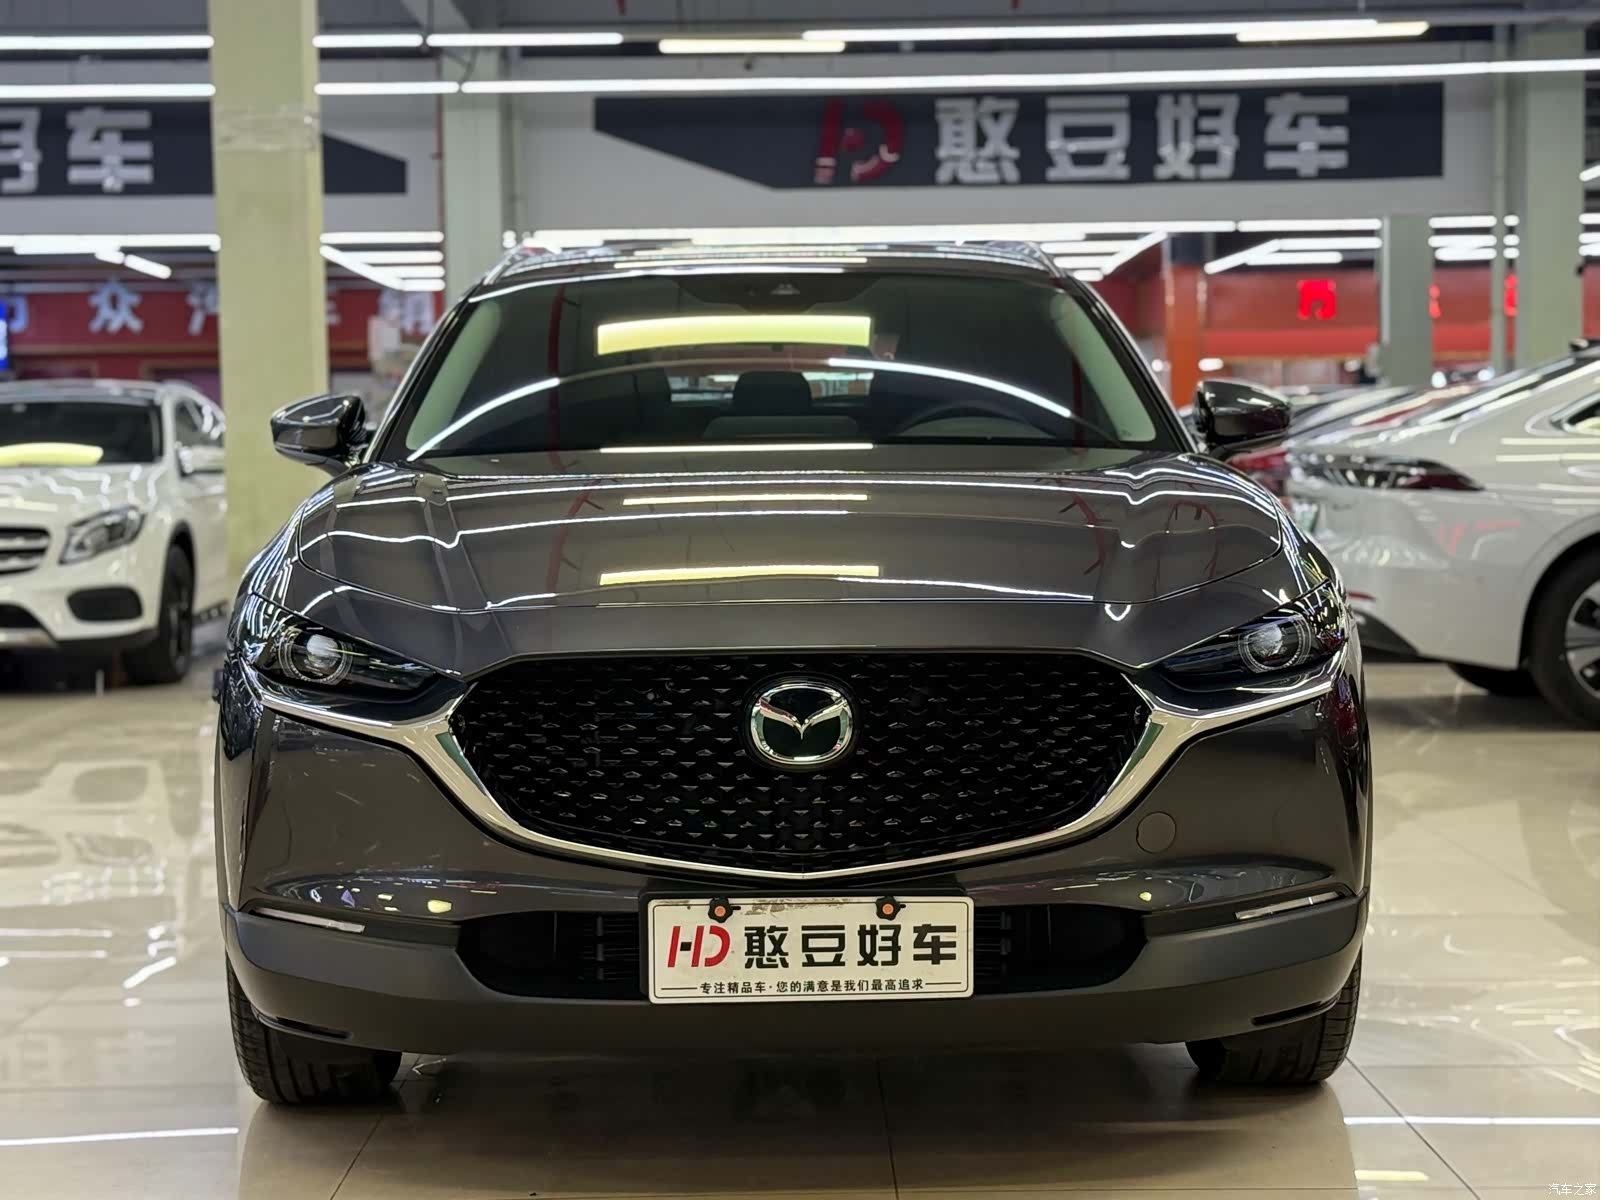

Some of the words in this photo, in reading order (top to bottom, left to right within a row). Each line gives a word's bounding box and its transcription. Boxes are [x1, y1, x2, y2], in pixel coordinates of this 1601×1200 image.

[934, 95, 1349, 185] 憨豆好车
[667, 925, 731, 968] HD
[744, 924, 957, 969] 憨豆好车
